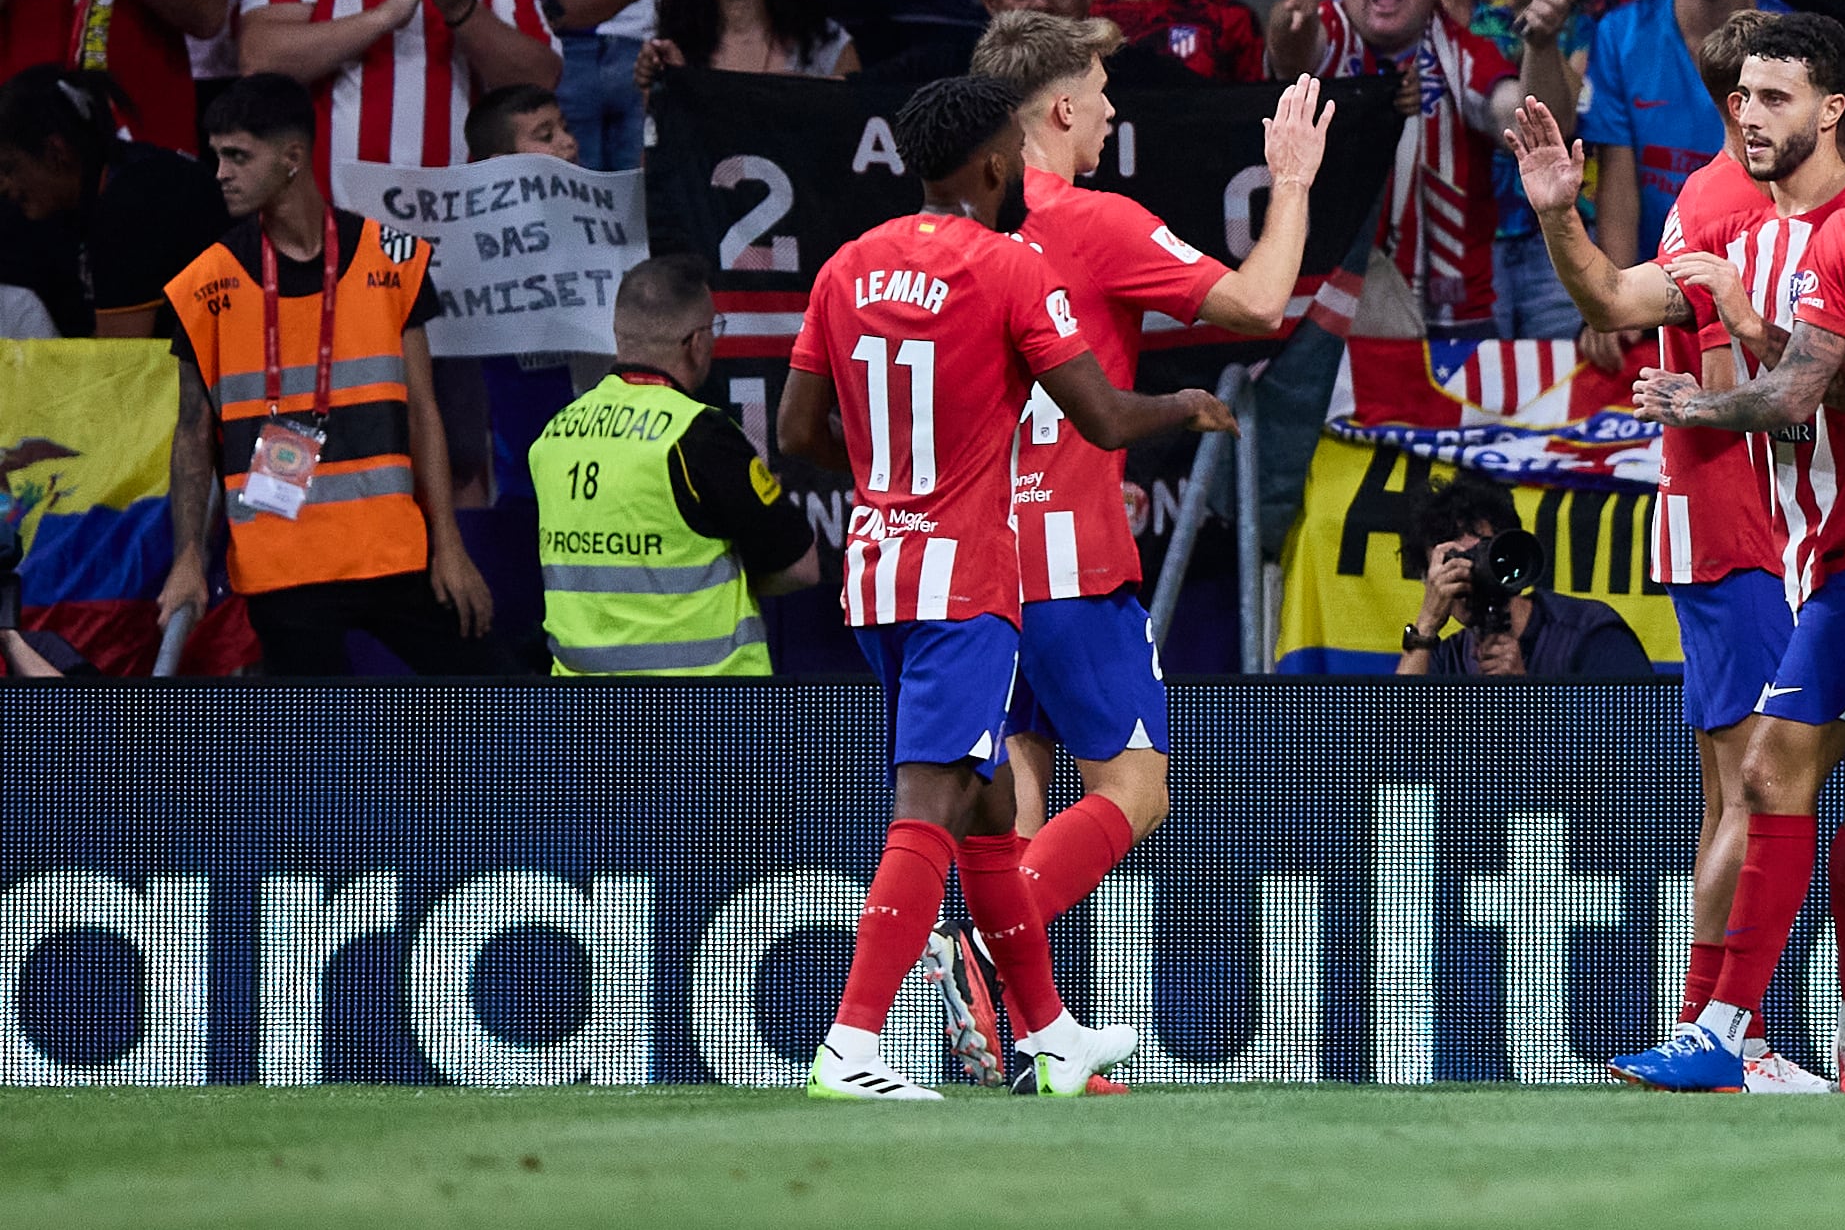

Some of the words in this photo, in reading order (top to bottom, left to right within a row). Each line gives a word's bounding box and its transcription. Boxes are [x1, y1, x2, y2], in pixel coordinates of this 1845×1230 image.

[383, 173, 615, 225] GRIEZMANN
[477, 220, 551, 263] DAS
[573, 216, 627, 251] TU
[439, 268, 622, 320] AMISET
[855, 269, 950, 315] LEMAR
[851, 334, 938, 495] 11
[1595, 416, 1662, 441] 201
[567, 460, 600, 501] 18
